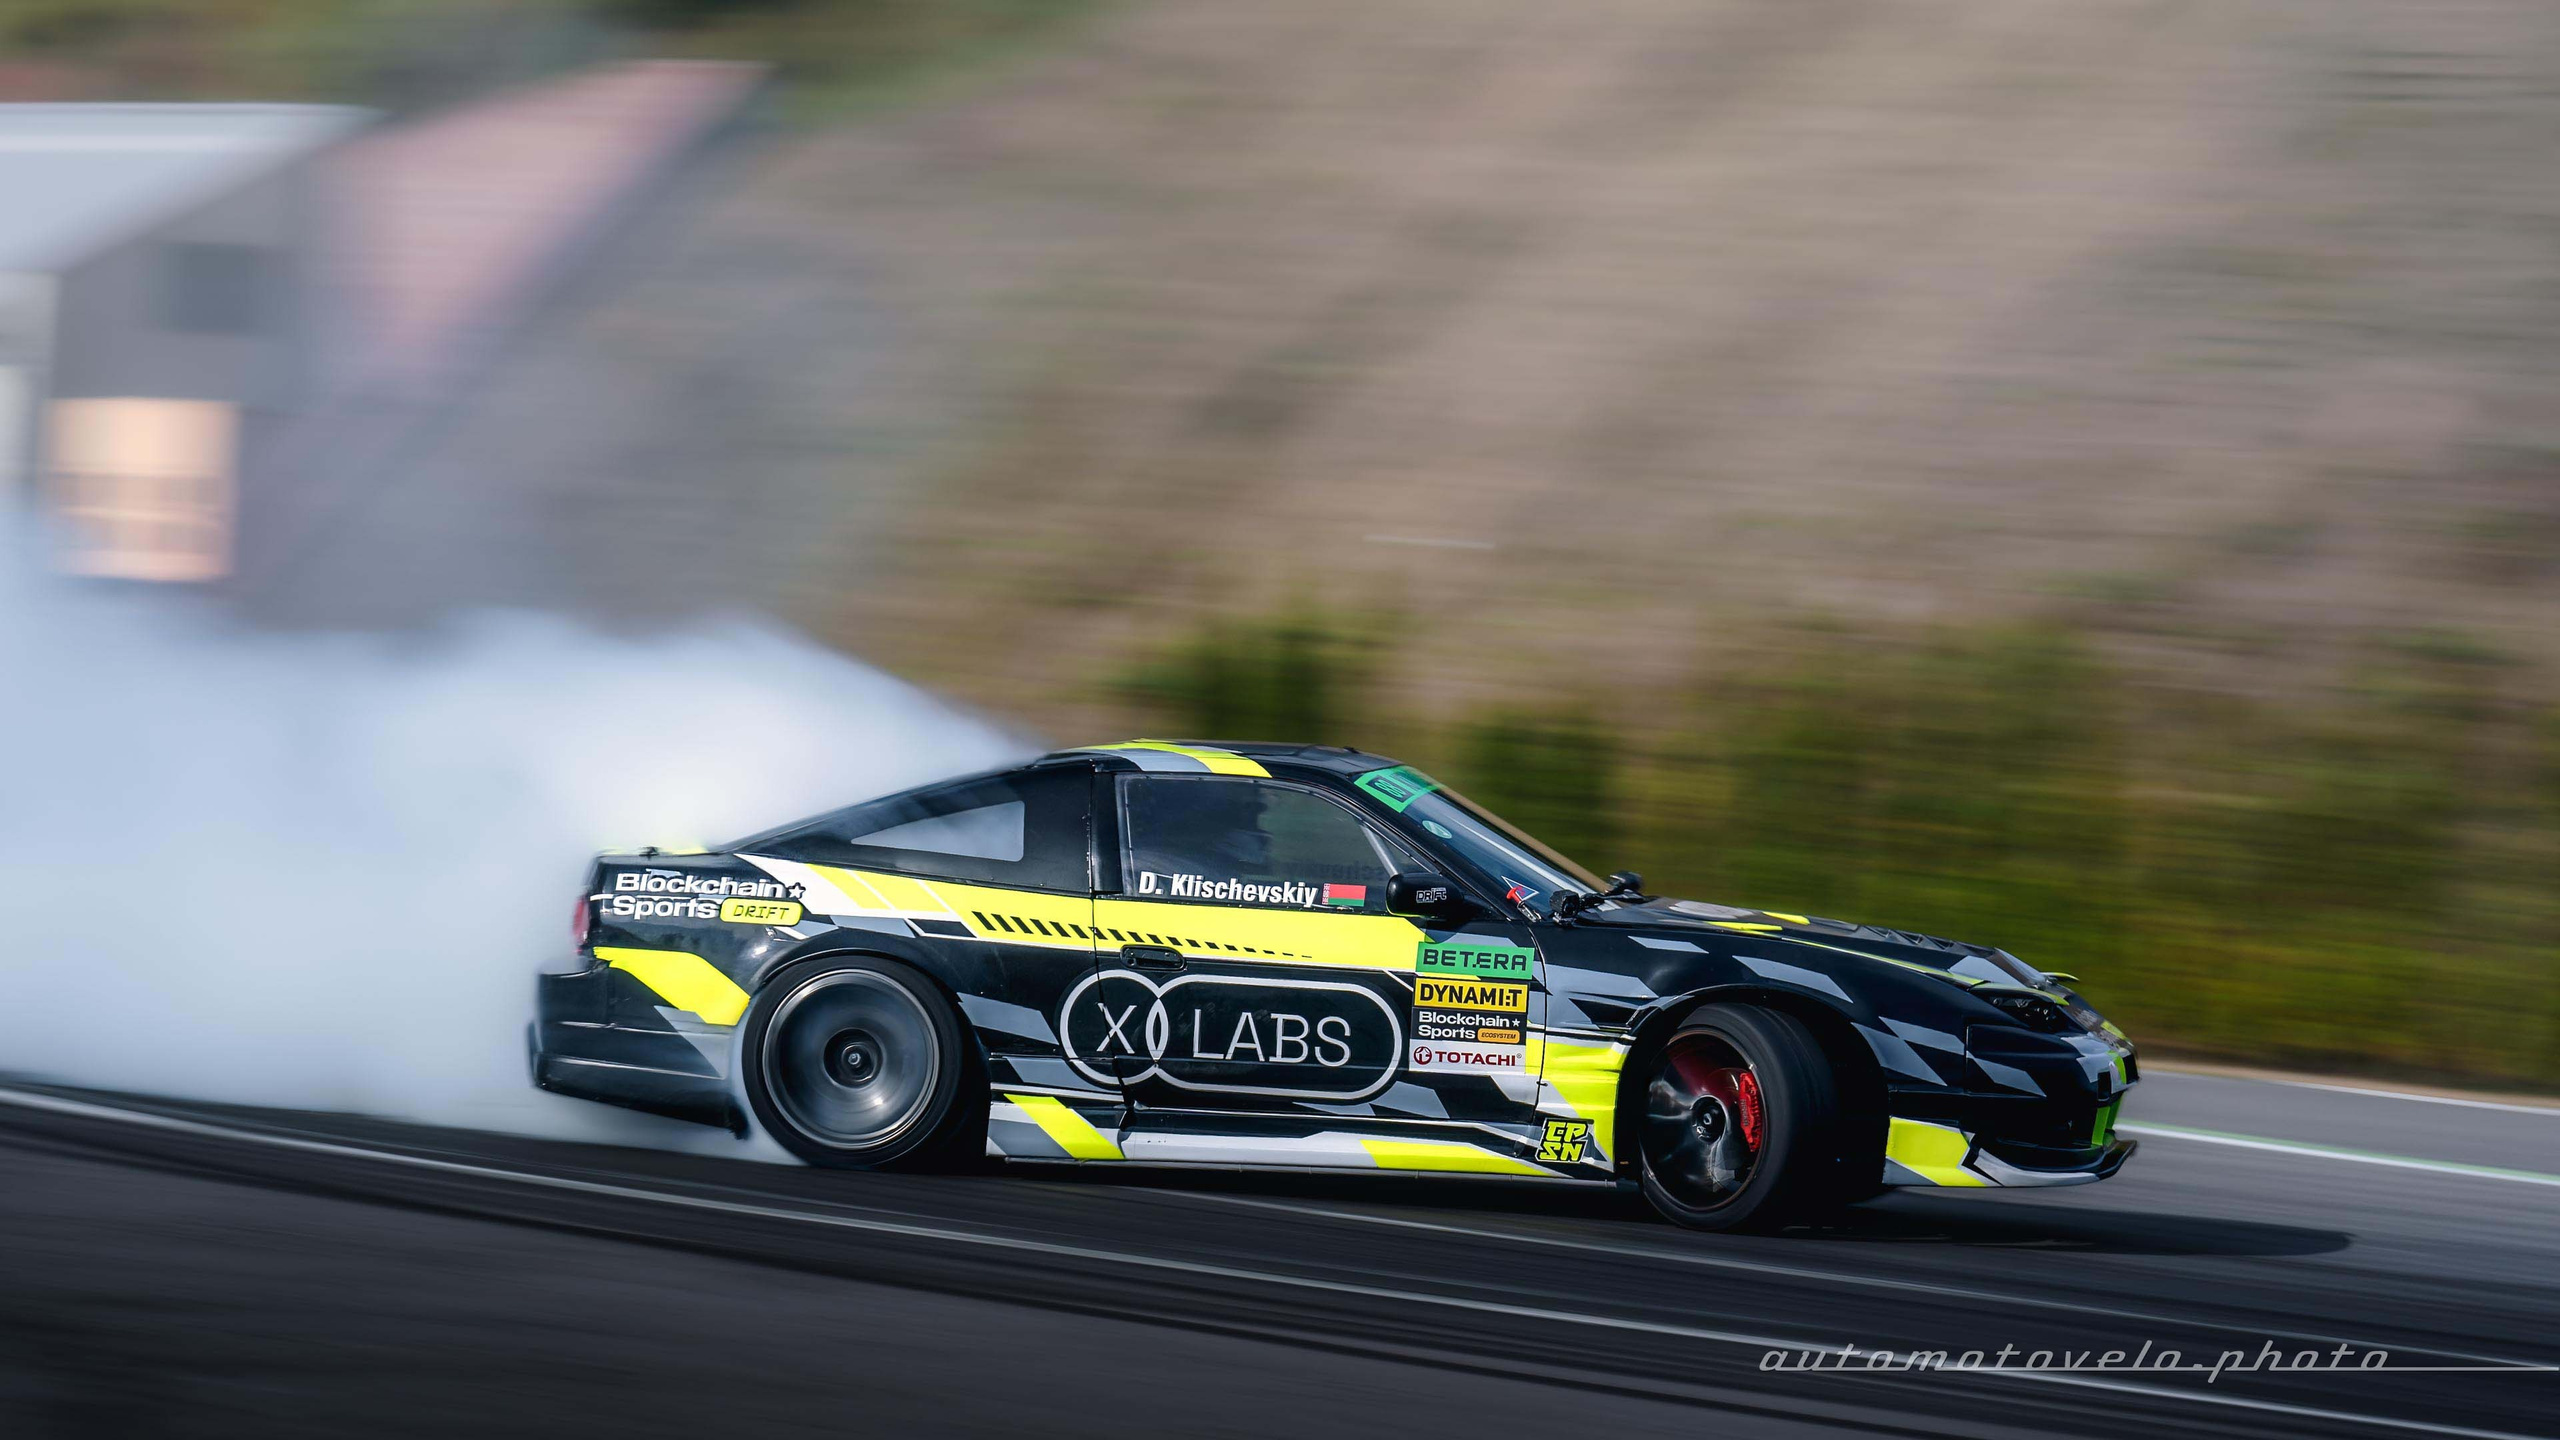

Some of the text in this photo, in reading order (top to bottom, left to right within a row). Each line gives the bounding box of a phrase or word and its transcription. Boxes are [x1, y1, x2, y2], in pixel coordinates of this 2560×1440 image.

[615, 872, 785, 898] Blockchain
[1138, 870, 1318, 908] D. Klischevskiy
[1416, 887, 1447, 903] DRIFT
[612, 894, 790, 920] Sports DRIFT
[1418, 1010, 1511, 1028] Blockchain
[1418, 1024, 1517, 1040] Sports ECOSYSTEM
[1095, 1002, 1351, 1067] X LABS
